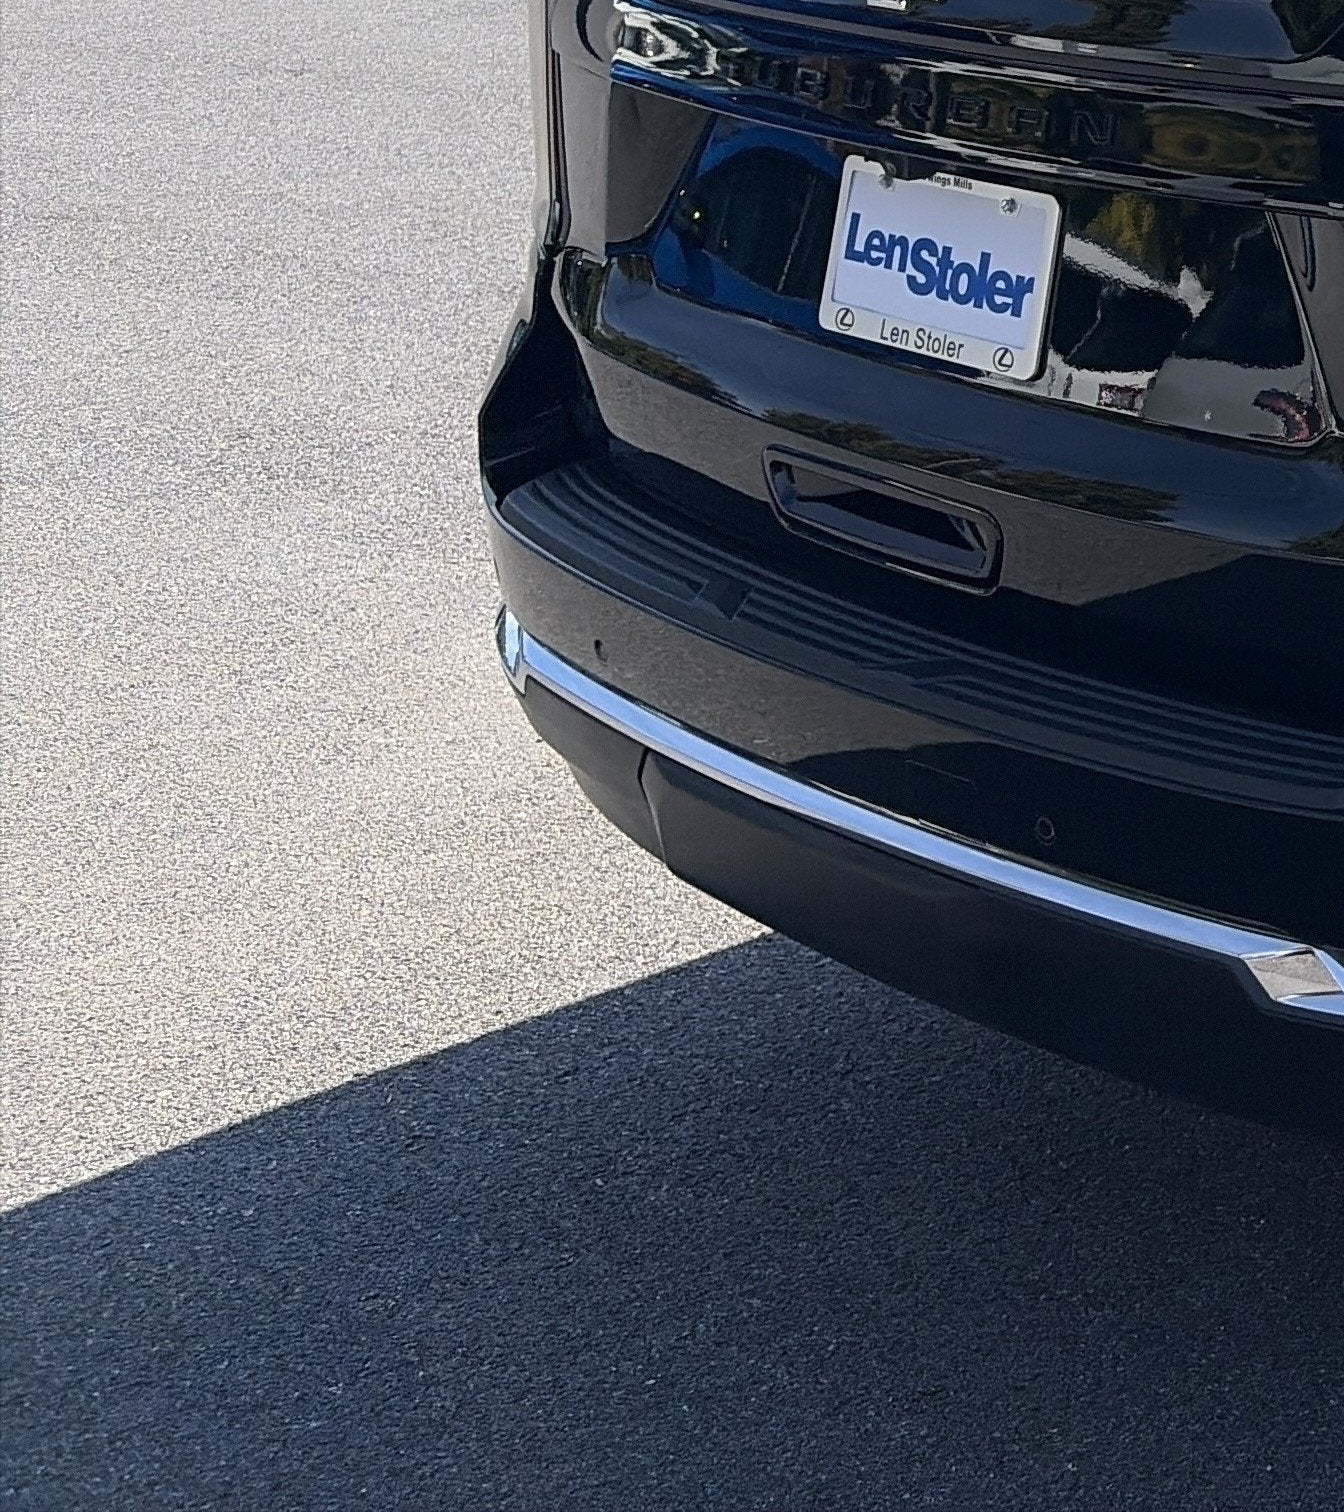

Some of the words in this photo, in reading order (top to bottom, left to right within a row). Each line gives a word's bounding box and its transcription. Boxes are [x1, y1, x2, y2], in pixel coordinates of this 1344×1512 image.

[953, 176, 973, 190] Mills
[879, 318, 910, 347] Len
[913, 327, 965, 360] Stoler
